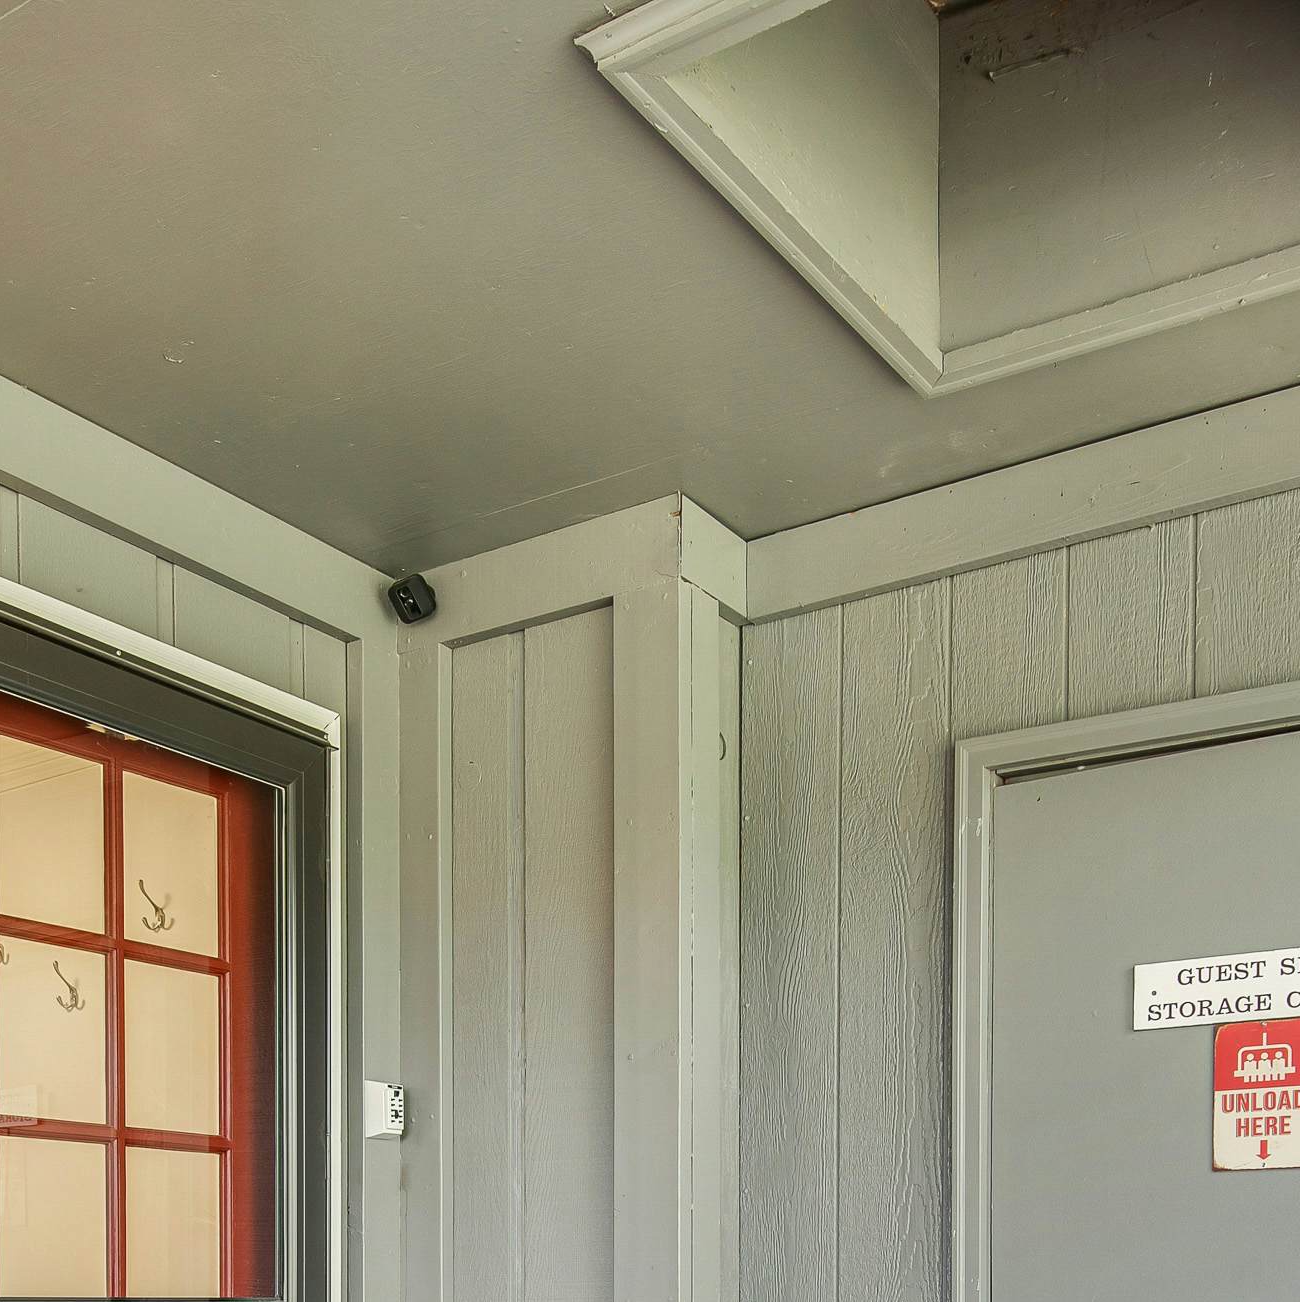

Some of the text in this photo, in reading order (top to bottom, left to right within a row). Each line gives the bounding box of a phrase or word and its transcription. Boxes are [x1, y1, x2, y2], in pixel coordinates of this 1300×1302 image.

[1176, 960, 1267, 986] GUEST
[1147, 993, 1273, 1022] STORAGE
[1235, 1115, 1292, 1137] HERE
